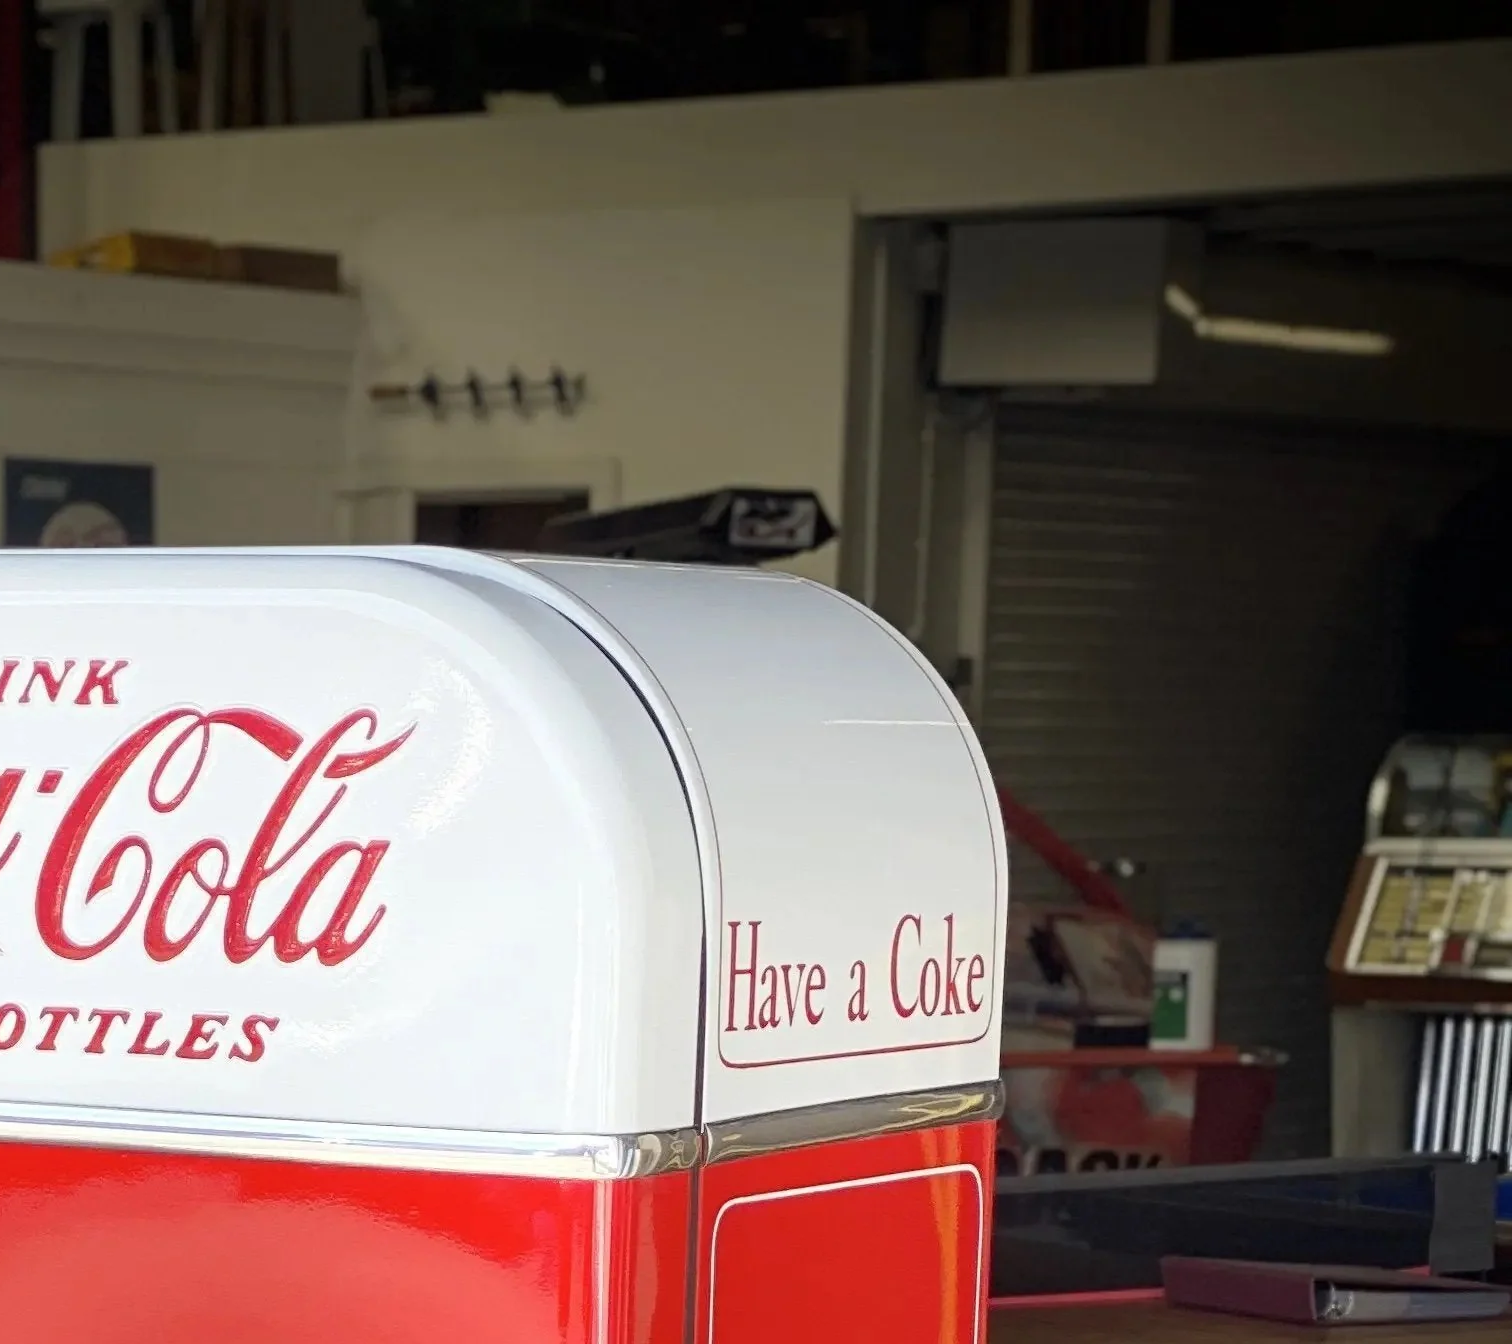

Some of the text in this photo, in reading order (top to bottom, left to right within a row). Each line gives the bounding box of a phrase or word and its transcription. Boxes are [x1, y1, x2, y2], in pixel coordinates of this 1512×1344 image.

[724, 912, 985, 1032] Have a Coke
